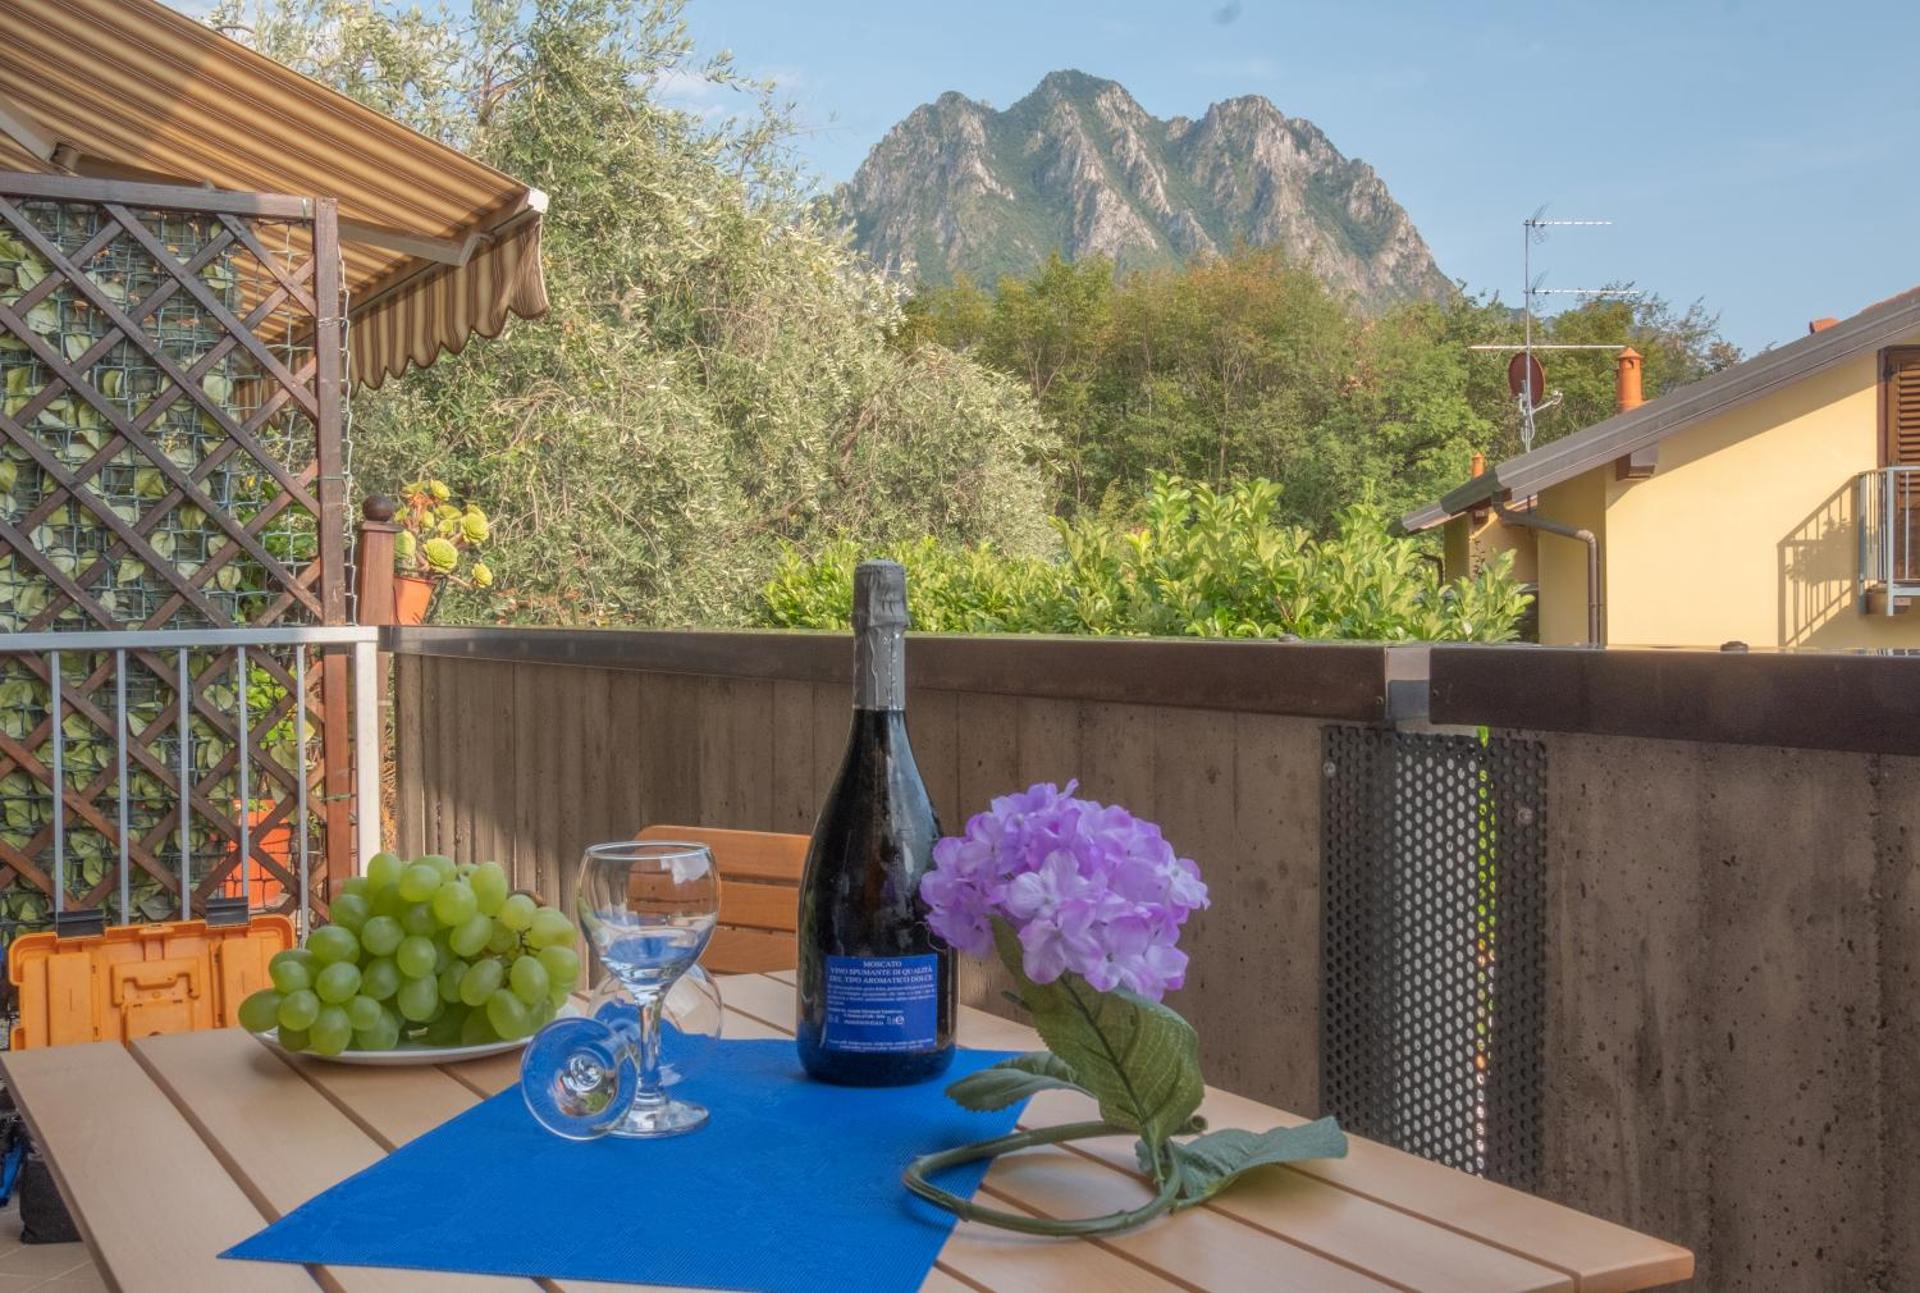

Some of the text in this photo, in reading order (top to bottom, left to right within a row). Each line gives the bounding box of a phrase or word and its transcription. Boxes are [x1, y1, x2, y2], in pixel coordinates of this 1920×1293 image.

[863, 960, 902, 968] MOSCATO
[830, 967, 848, 975] VINO
[849, 968, 892, 976] SPUMANTE
[863, 976, 909, 984] AROMATICO
[910, 974, 932, 982] DOLCE
